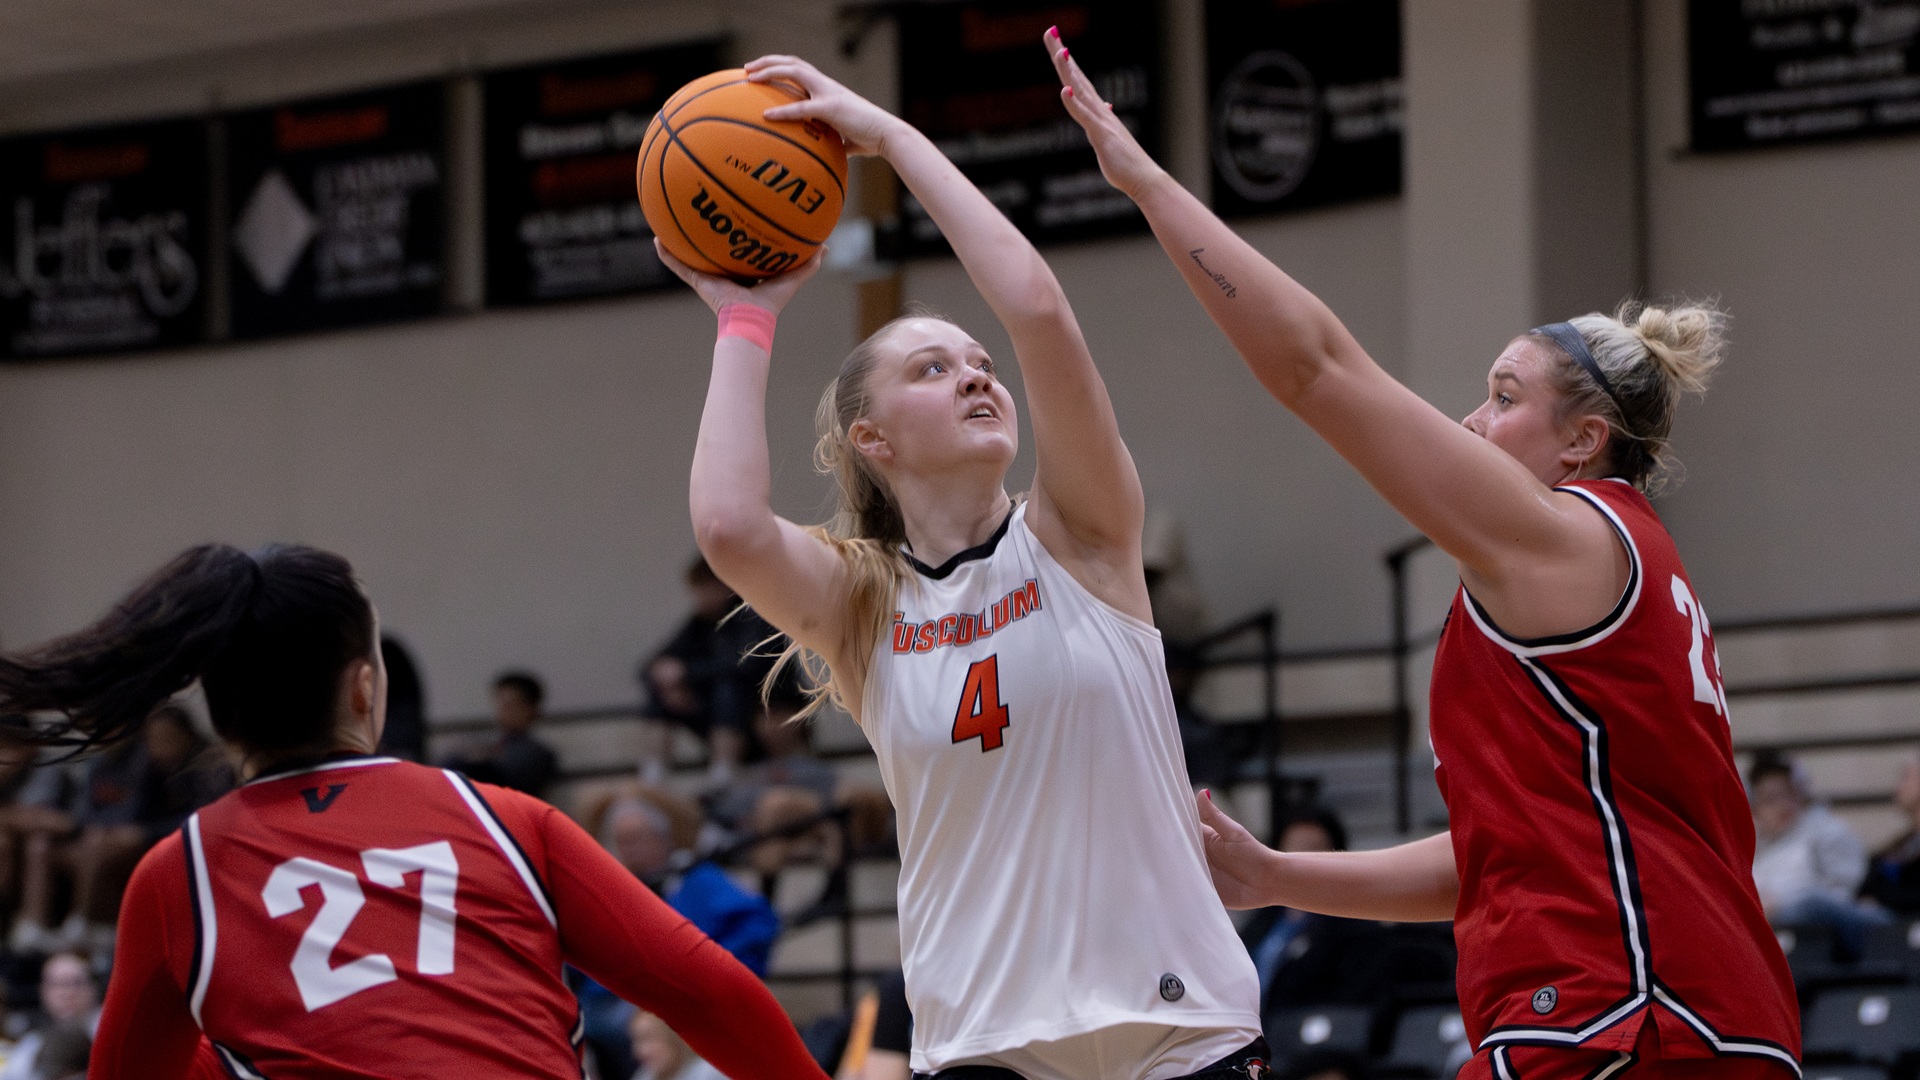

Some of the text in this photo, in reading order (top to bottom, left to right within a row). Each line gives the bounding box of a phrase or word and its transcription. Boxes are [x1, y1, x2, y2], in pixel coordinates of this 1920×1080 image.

[725, 154, 826, 215] EVO NXT
[691, 187, 799, 275] Wilson
[893, 578, 1042, 654] USCULUM
[952, 652, 1010, 754] 4
[261, 840, 459, 1013] 27
